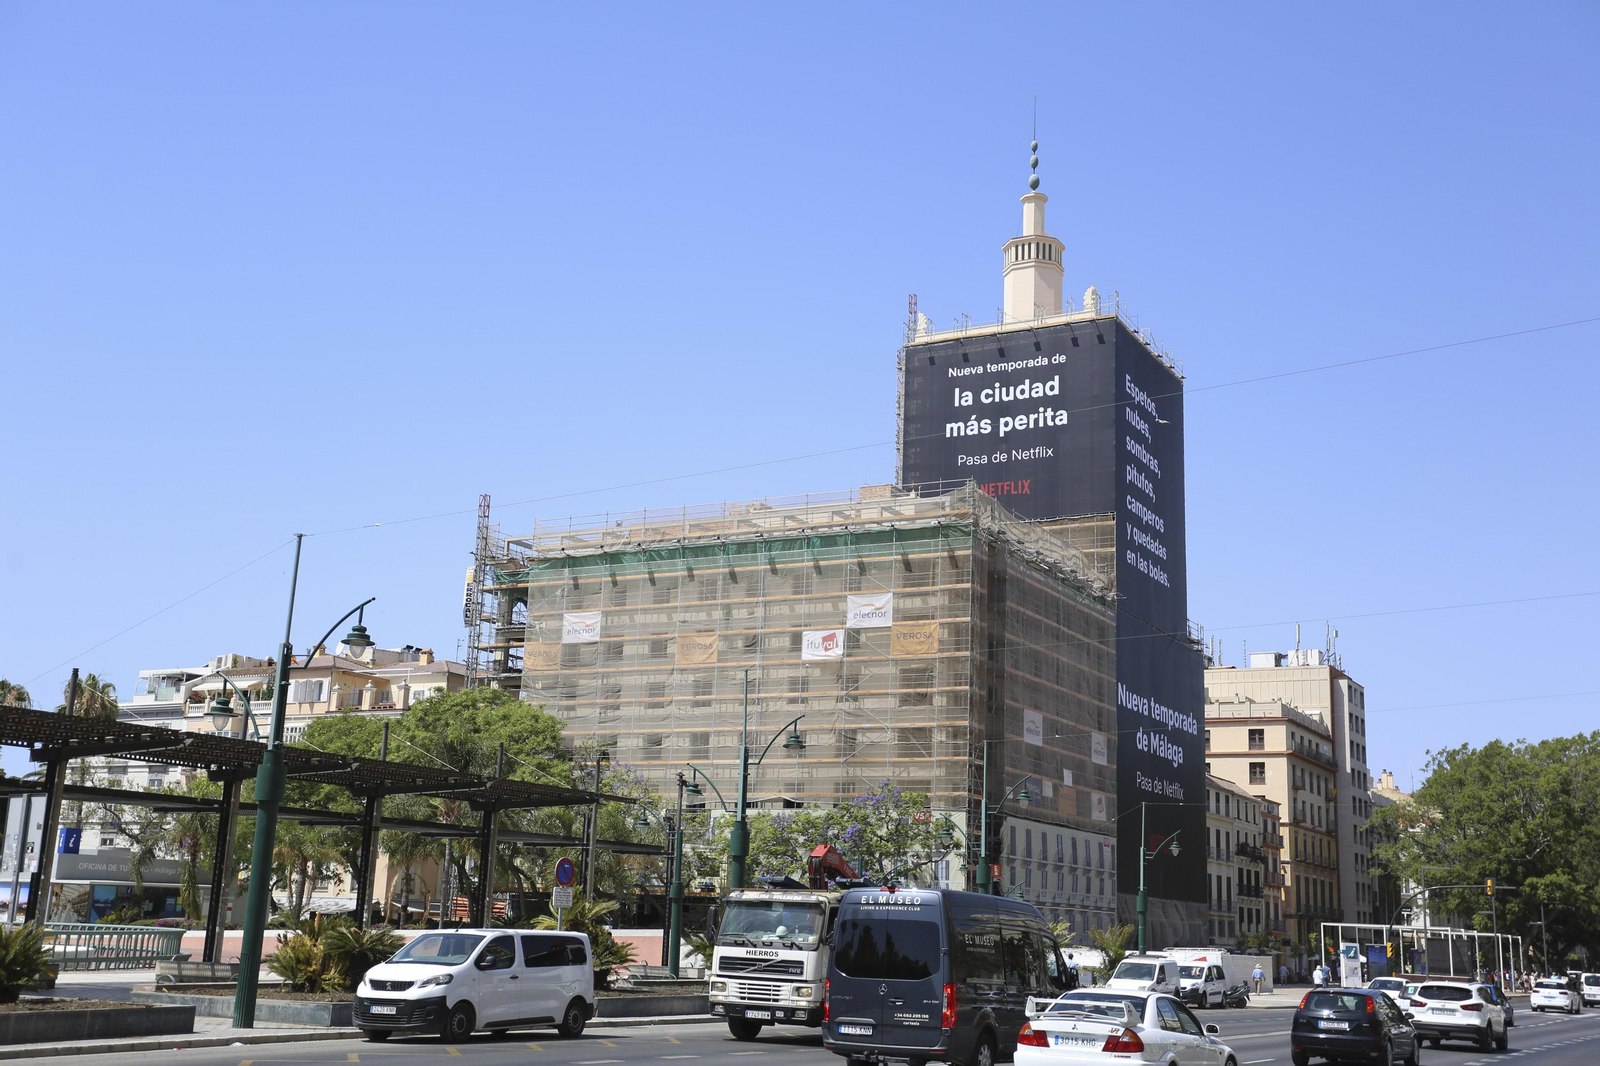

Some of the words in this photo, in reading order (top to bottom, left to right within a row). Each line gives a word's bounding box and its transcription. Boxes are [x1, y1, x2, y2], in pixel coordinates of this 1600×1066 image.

[948, 365, 983, 378] Nueva
[987, 356, 1048, 372] temporada
[1052, 353, 1067, 364] de
[954, 387, 973, 407] la
[980, 375, 1060, 404] ciudad
[1126, 373, 1159, 420] Espetos,
[945, 414, 992, 438] más
[999, 406, 1068, 437] perita
[1126, 406, 1151, 444] nubes,
[958, 454, 988, 466] Pasa
[992, 451, 1008, 463] de
[1012, 446, 1054, 461] Netflix
[1126, 435, 1161, 479] sombras,
[980, 479, 1031, 497] NETFLIX
[1126, 463, 1156, 503] pitufos,
[1126, 494, 1164, 533] camperos
[1126, 522, 1132, 540] y
[1133, 527, 1167, 560] quedadas
[1126, 549, 1136, 567] en
[1137, 552, 1148, 574] las
[1149, 560, 1170, 588] bolas.
[853, 610, 888, 619] elecnor
[567, 627, 596, 635] elecnor
[896, 632, 935, 640] VEROSA
[1118, 682, 1149, 716] Nueva
[1151, 697, 1198, 735] temporada
[1136, 727, 1148, 752] de
[1150, 731, 1184, 768] Málaga
[1136, 771, 1152, 792] Pasa
[1153, 777, 1162, 794] de
[1163, 779, 1184, 800] Netflix
[78, 862, 107, 872] OFICINA
[108, 864, 117, 872] DE
[861, 895, 874, 904] EL
[878, 895, 921, 905] MUSEO
[964, 934, 973, 945] EL
[974, 935, 995, 947] MUSEO
[1060, 1036, 1079, 1046] 3015
[1081, 1038, 1096, 1047] KHG
